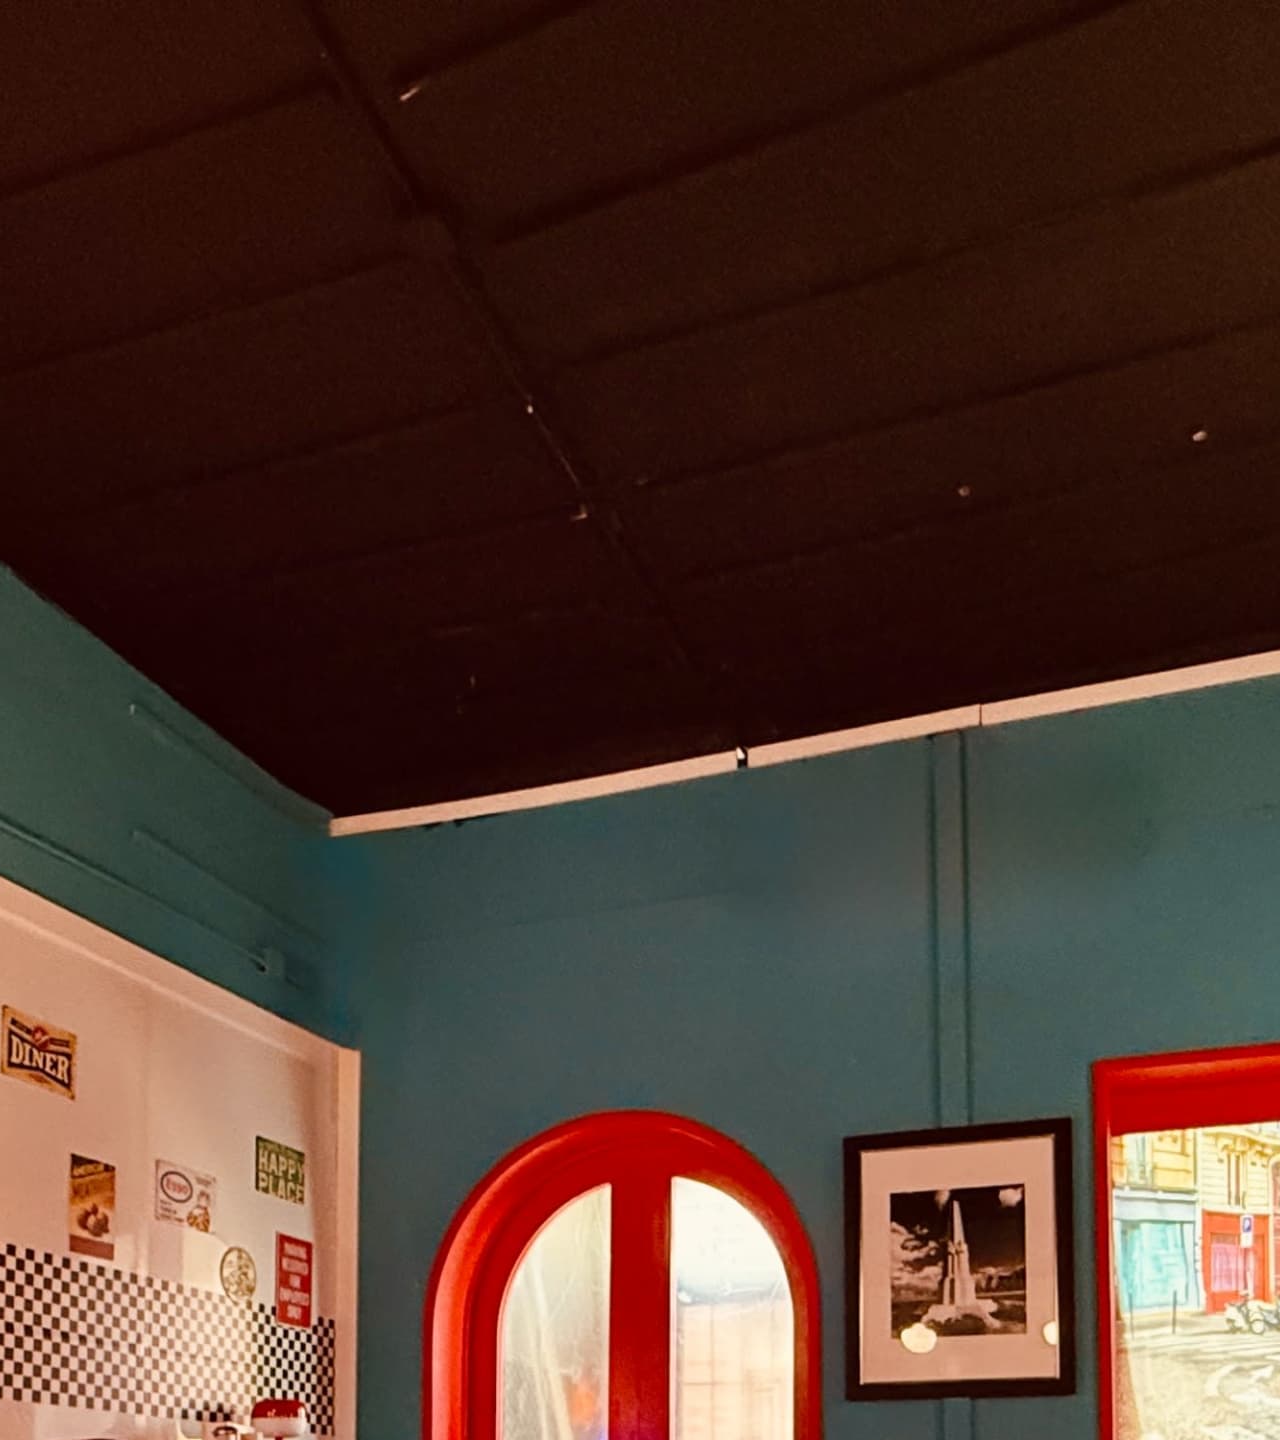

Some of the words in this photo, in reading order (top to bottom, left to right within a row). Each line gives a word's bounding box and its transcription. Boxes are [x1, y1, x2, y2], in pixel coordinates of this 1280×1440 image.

[9, 1033, 70, 1085] DINER
[259, 1147, 304, 1185] HAPPY
[259, 1171, 304, 1204] PLACE
